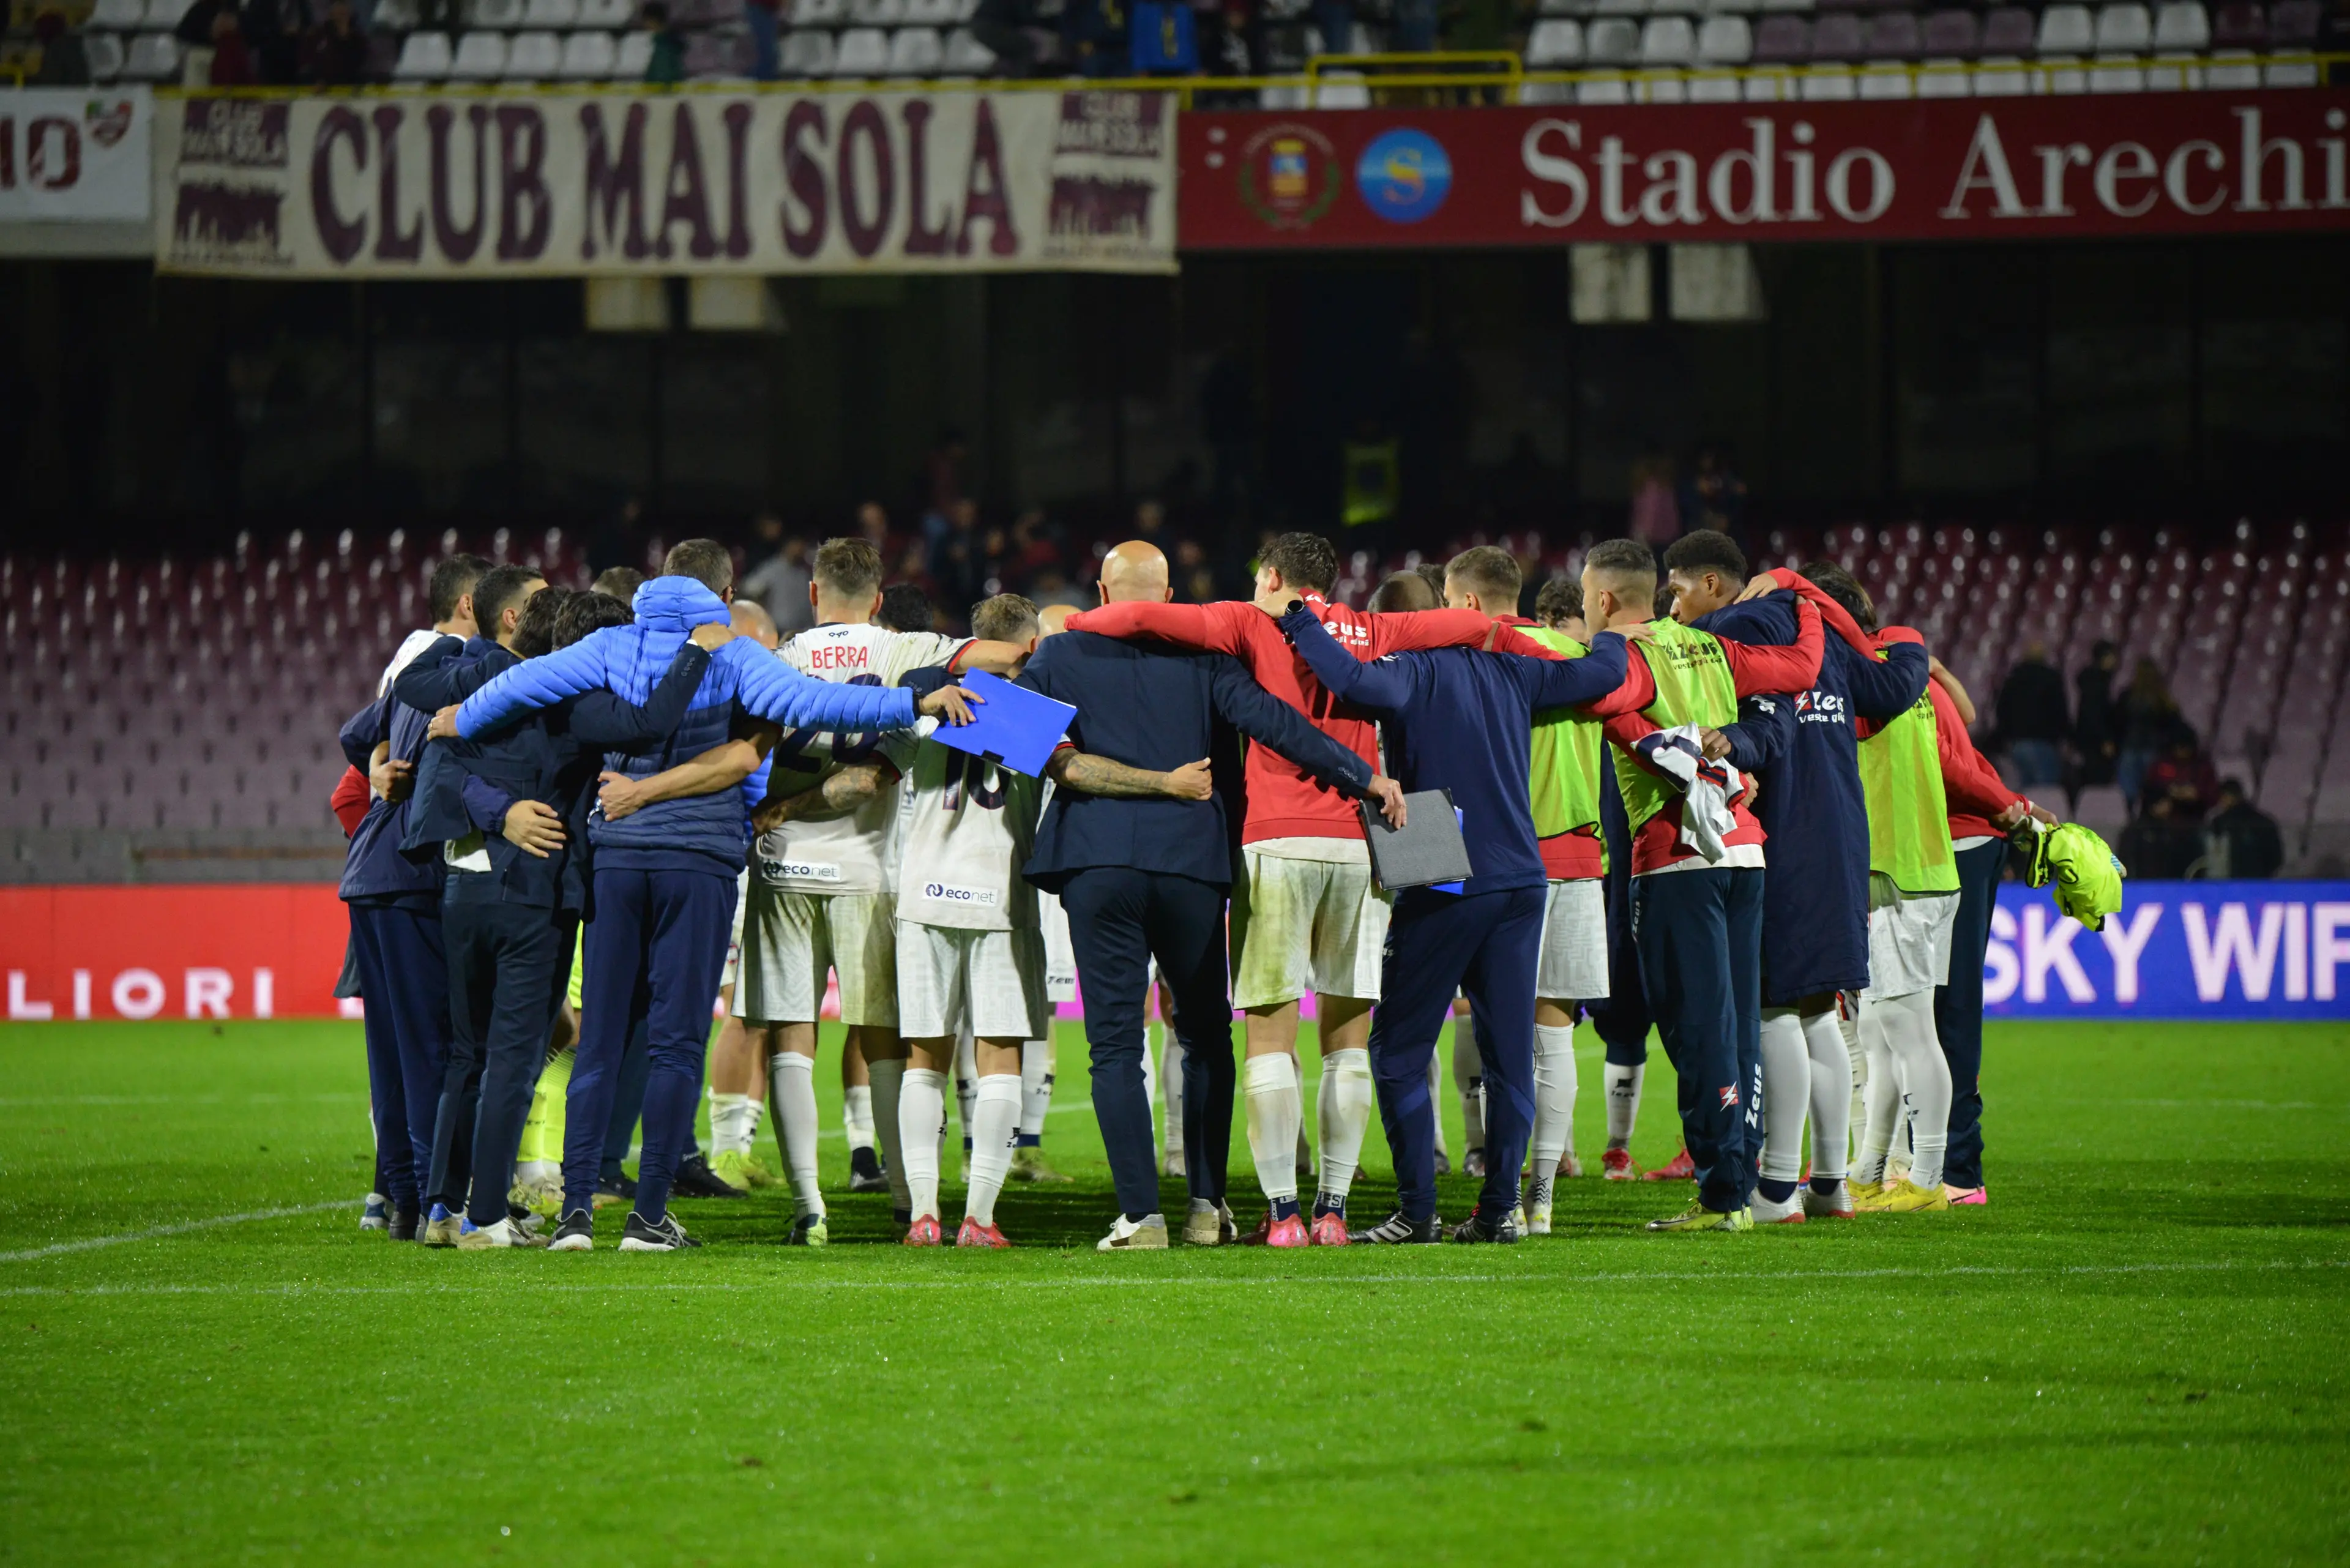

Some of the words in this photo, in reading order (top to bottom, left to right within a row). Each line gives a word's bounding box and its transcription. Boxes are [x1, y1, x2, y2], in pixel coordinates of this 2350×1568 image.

[310, 102, 554, 264] CLUB
[577, 98, 755, 261] MAI
[778, 96, 1020, 261] SOLA
[1520, 116, 1896, 228] Stadio
[1938, 105, 2350, 219] Arechi
[1319, 620, 1367, 638] eus
[811, 646, 868, 670] BERRA
[783, 863, 838, 878] econet
[946, 888, 995, 904] econet
[1983, 902, 2164, 1004] SKY
[2180, 901, 2350, 1002] WIF
[7, 966, 274, 1021] LIORI
[1744, 1063, 1762, 1130] Zeus
